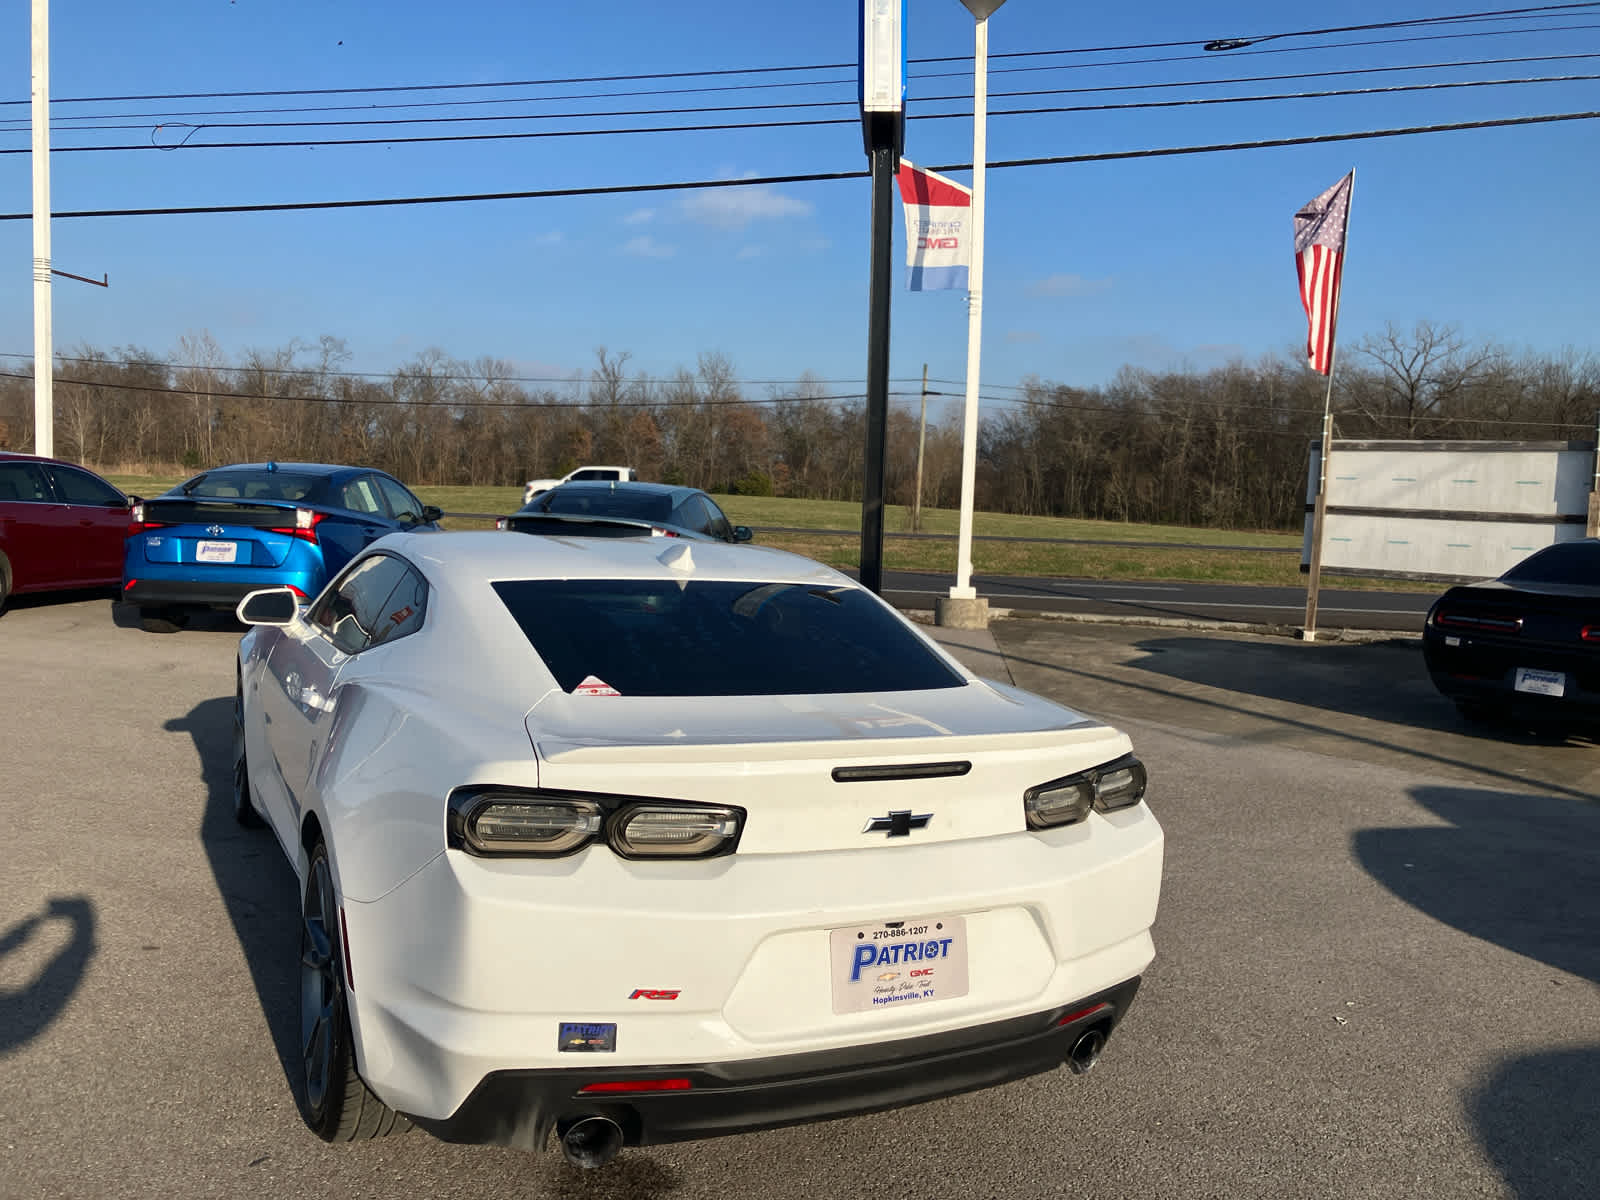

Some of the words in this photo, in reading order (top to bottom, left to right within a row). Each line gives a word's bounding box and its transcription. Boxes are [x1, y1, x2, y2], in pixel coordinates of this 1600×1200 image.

[873, 926, 928, 939] 270-886-1207
[849, 938, 952, 982] PATRIOT
[910, 968, 934, 977] GMC
[628, 989, 681, 1000] RS
[873, 992, 921, 1005] Hopkinsville,
[923, 989, 934, 997] KY
